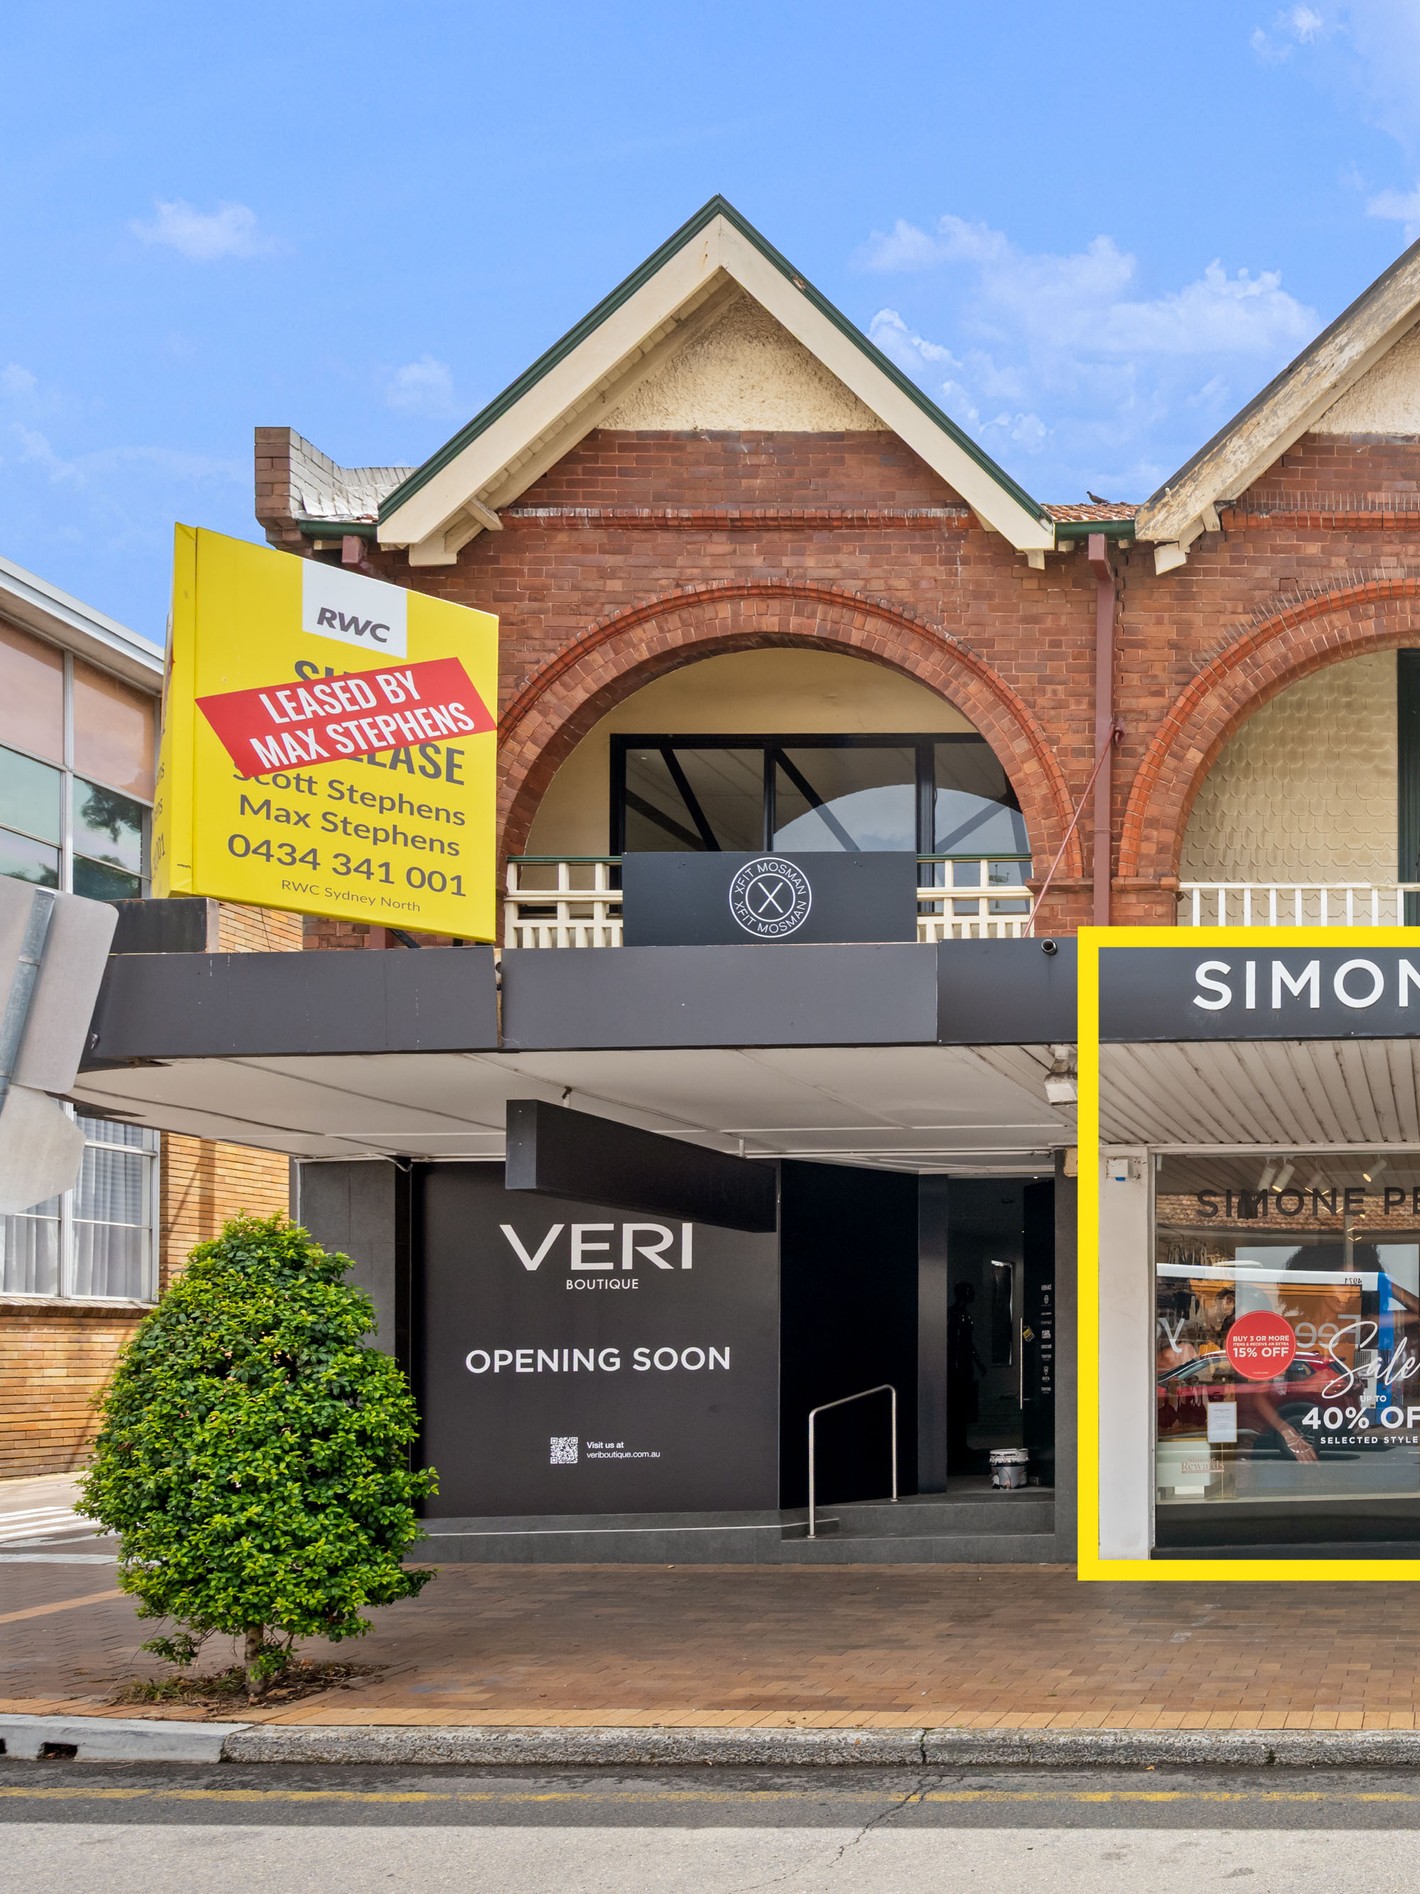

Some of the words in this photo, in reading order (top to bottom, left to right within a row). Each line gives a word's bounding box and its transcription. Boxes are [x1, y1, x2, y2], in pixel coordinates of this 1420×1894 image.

[316, 606, 391, 644] RWC
[258, 678, 378, 725] LEASED
[375, 670, 421, 704] BY
[250, 728, 331, 769] MAX
[326, 702, 475, 754] STEPHENS
[327, 779, 467, 826] Stephens
[239, 794, 311, 828] Max
[321, 811, 460, 857] Stephens
[227, 833, 321, 871] 0434
[331, 852, 395, 884] 341
[405, 866, 467, 897] 001
[734, 867, 755, 895] XFIT
[756, 862, 807, 895] MOSMAN
[281, 879, 320, 896] RWC
[324, 887, 377, 907] Sydney
[380, 896, 421, 912] North
[757, 882, 784, 913] X
[734, 900, 757, 926] XFIT
[757, 900, 807, 934] MOSMAN
[1199, 1187, 1366, 1219] SIMONE
[499, 1222, 693, 1271] VERI
[566, 1278, 639, 1291] BOUTIQUE
[465, 1348, 621, 1374] OPENING
[632, 1346, 730, 1371] SOON
[1233, 1347, 1258, 1357] 15%
[1261, 1347, 1289, 1357] OFF
[1301, 1406, 1370, 1429] 40%
[586, 1441, 603, 1449] Visit
[616, 1441, 624, 1449] at
[586, 1451, 661, 1459] veriboutique.com.au
[1320, 1436, 1379, 1444] SELECTED
